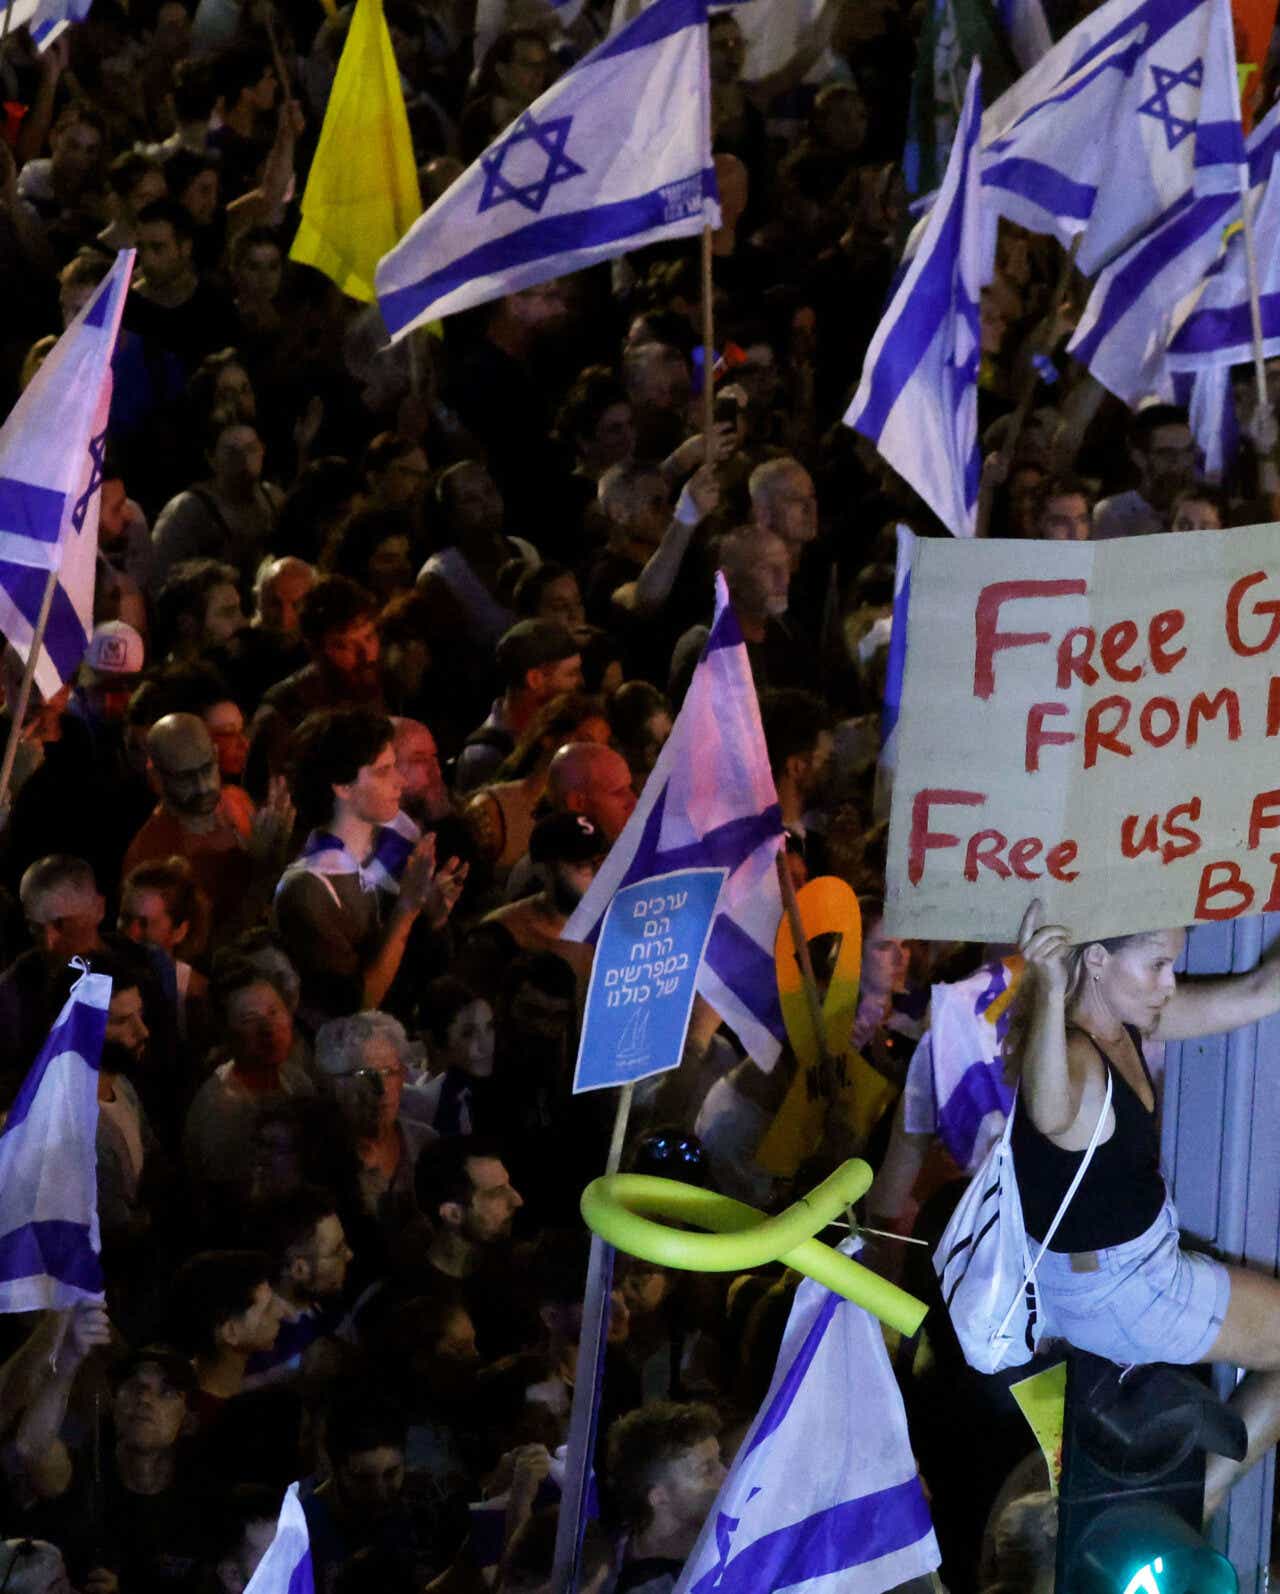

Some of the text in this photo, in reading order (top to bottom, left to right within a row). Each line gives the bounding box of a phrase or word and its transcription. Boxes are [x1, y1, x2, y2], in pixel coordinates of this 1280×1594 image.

[1025, 687, 1242, 773] FROM
[633, 890, 689, 918] ערכים
[643, 916, 671, 938] הם
[630, 937, 674, 961] הרוח
[604, 953, 690, 987] במפרשים
[607, 976, 680, 1009] של כולנו
